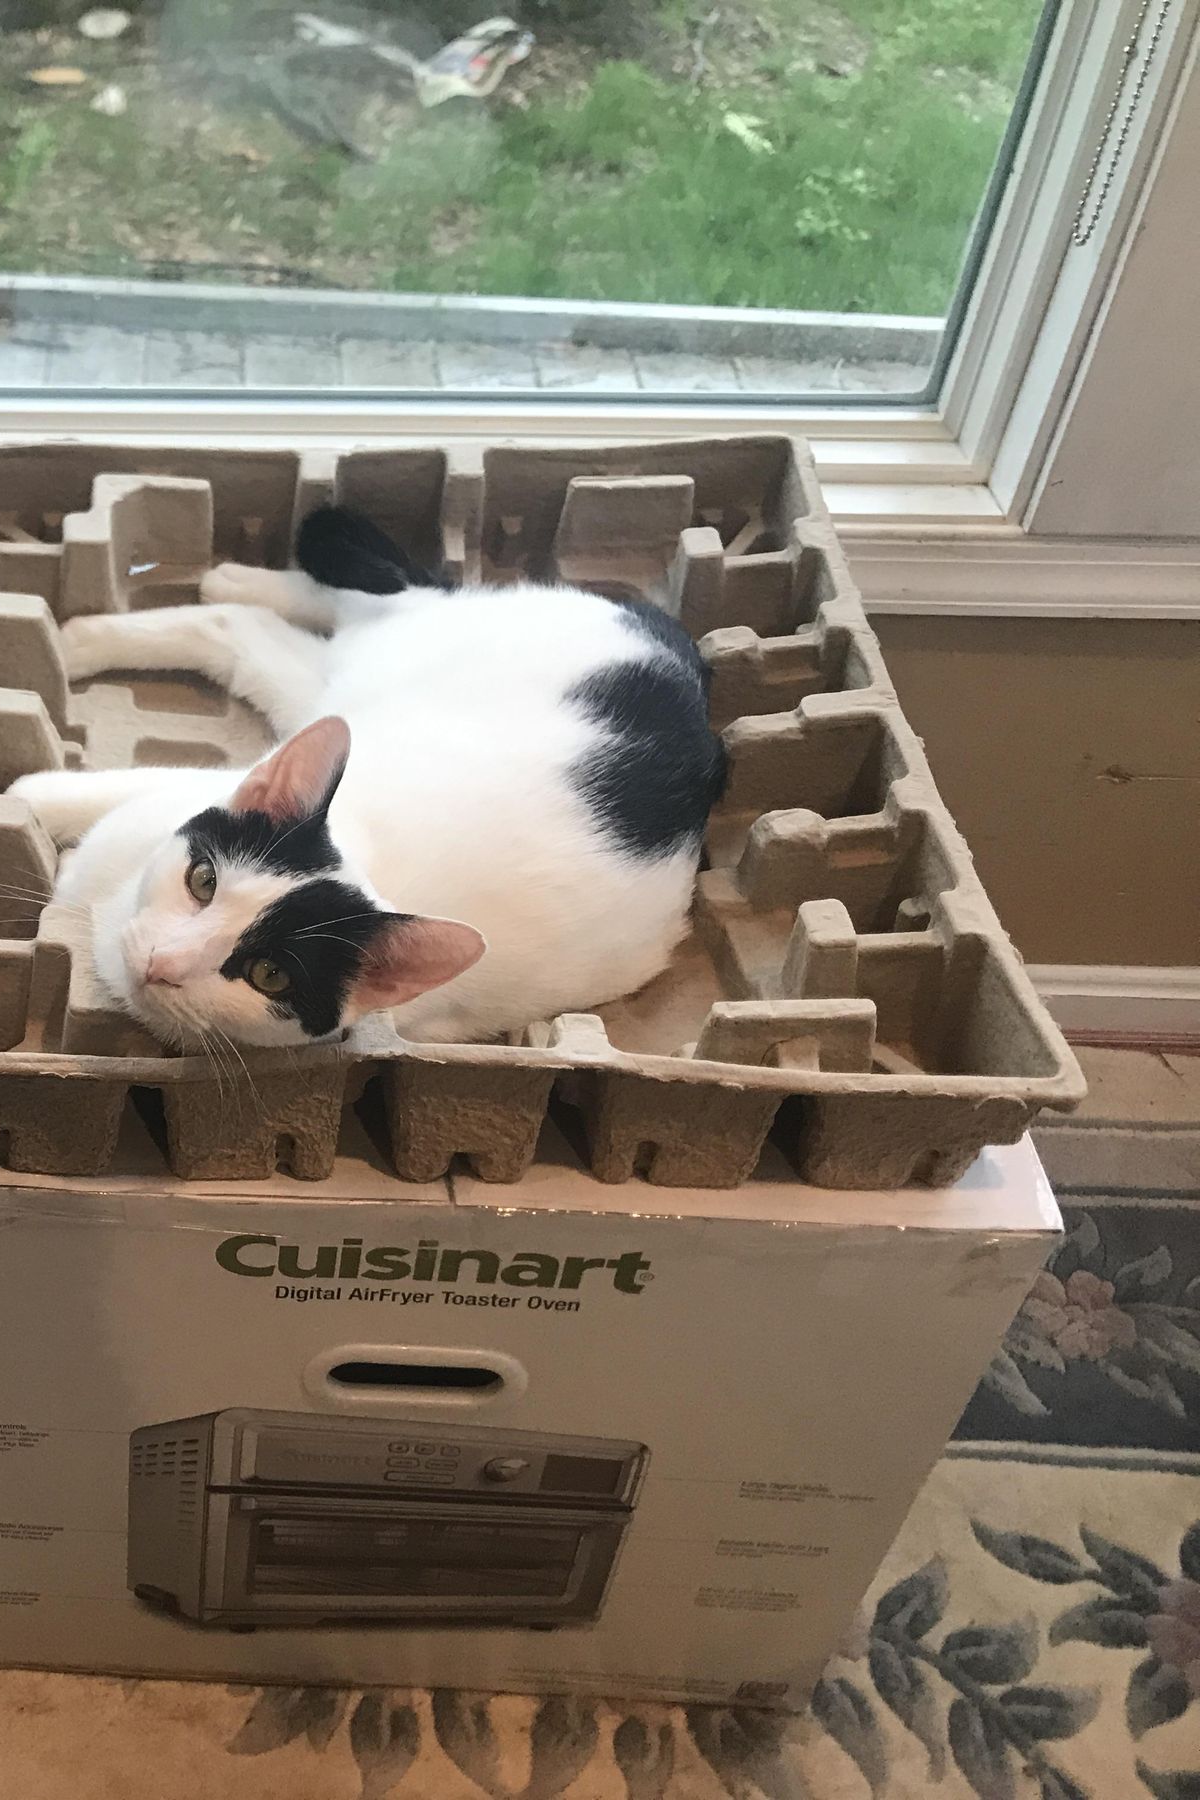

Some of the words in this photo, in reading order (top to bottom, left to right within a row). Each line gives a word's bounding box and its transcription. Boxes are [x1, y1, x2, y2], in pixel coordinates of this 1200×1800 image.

[215, 1234, 652, 1294] Cuisinart
[274, 1285, 342, 1303] Digital
[348, 1287, 435, 1306] AirFryer
[441, 1290, 521, 1309] Toaster
[527, 1295, 581, 1313] Oven
